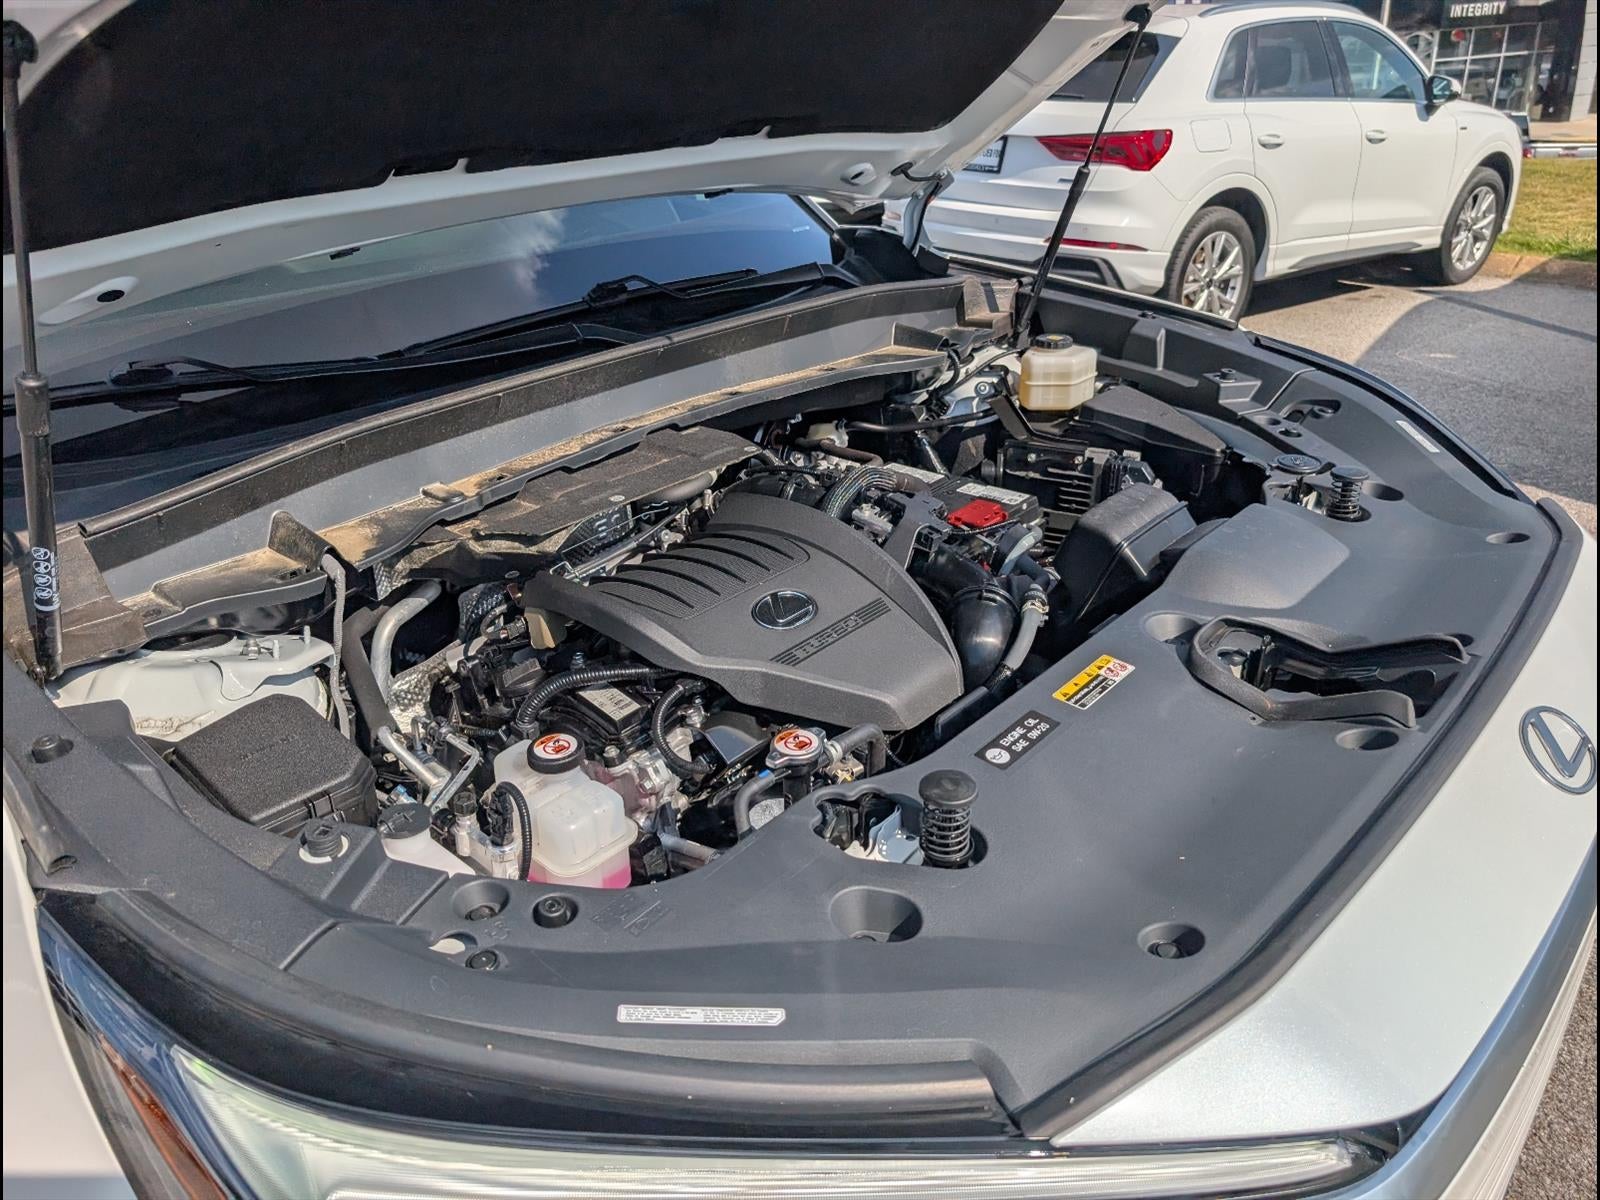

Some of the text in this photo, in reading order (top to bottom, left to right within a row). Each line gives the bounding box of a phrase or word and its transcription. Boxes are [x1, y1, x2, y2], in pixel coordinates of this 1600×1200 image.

[1450, 1, 1507, 18] INTEGRITY
[794, 612, 863, 656] TURBO
[1000, 718, 1039, 746] ENGINE OIL
[1011, 722, 1050, 752] SAE 0W-20
